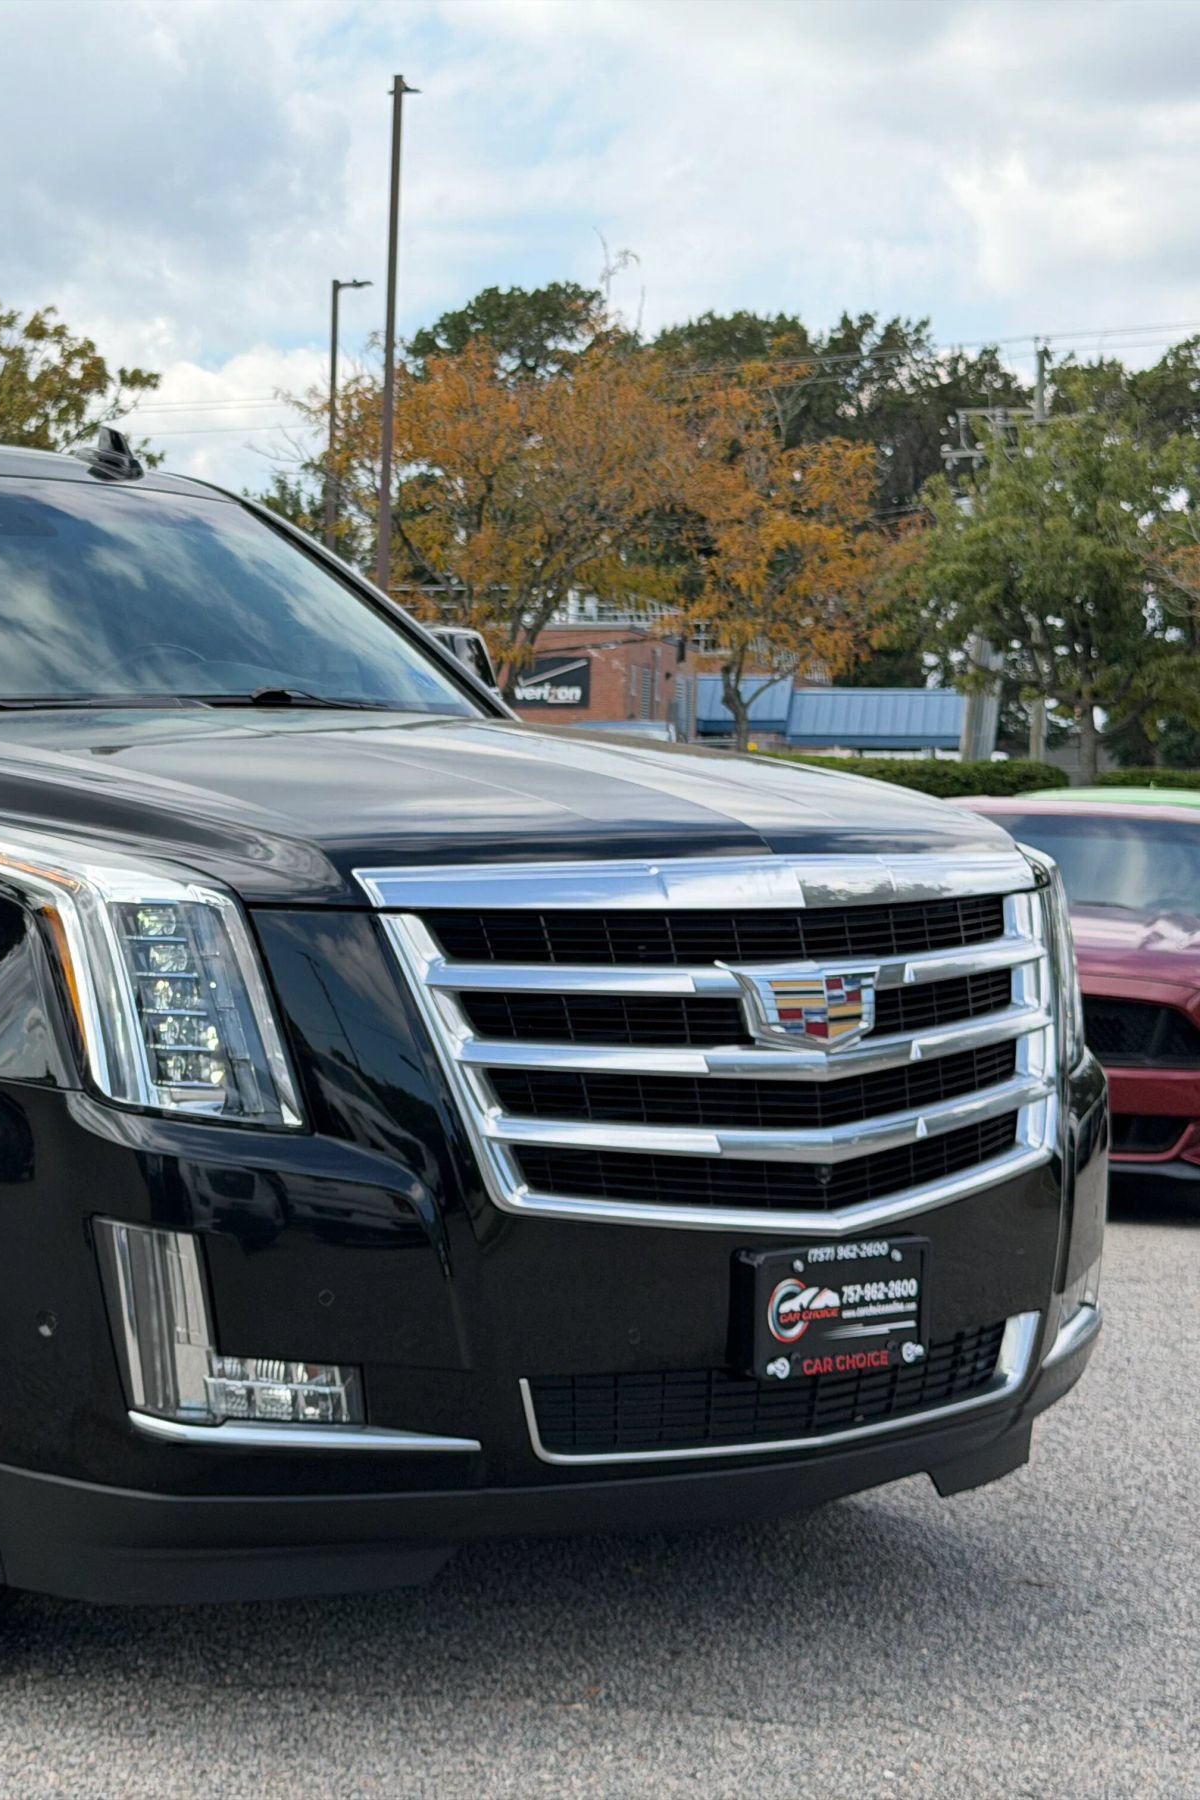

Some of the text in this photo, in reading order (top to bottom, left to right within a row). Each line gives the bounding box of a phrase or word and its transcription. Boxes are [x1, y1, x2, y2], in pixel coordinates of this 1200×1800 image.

[514, 682, 582, 703] verizon
[807, 1241, 889, 1263] (757) 962-2600
[841, 1278, 918, 1304] 757-962-2600
[779, 1308, 840, 1324] CAR CHOICE
[803, 1350, 889, 1376] CAR CHOICE
